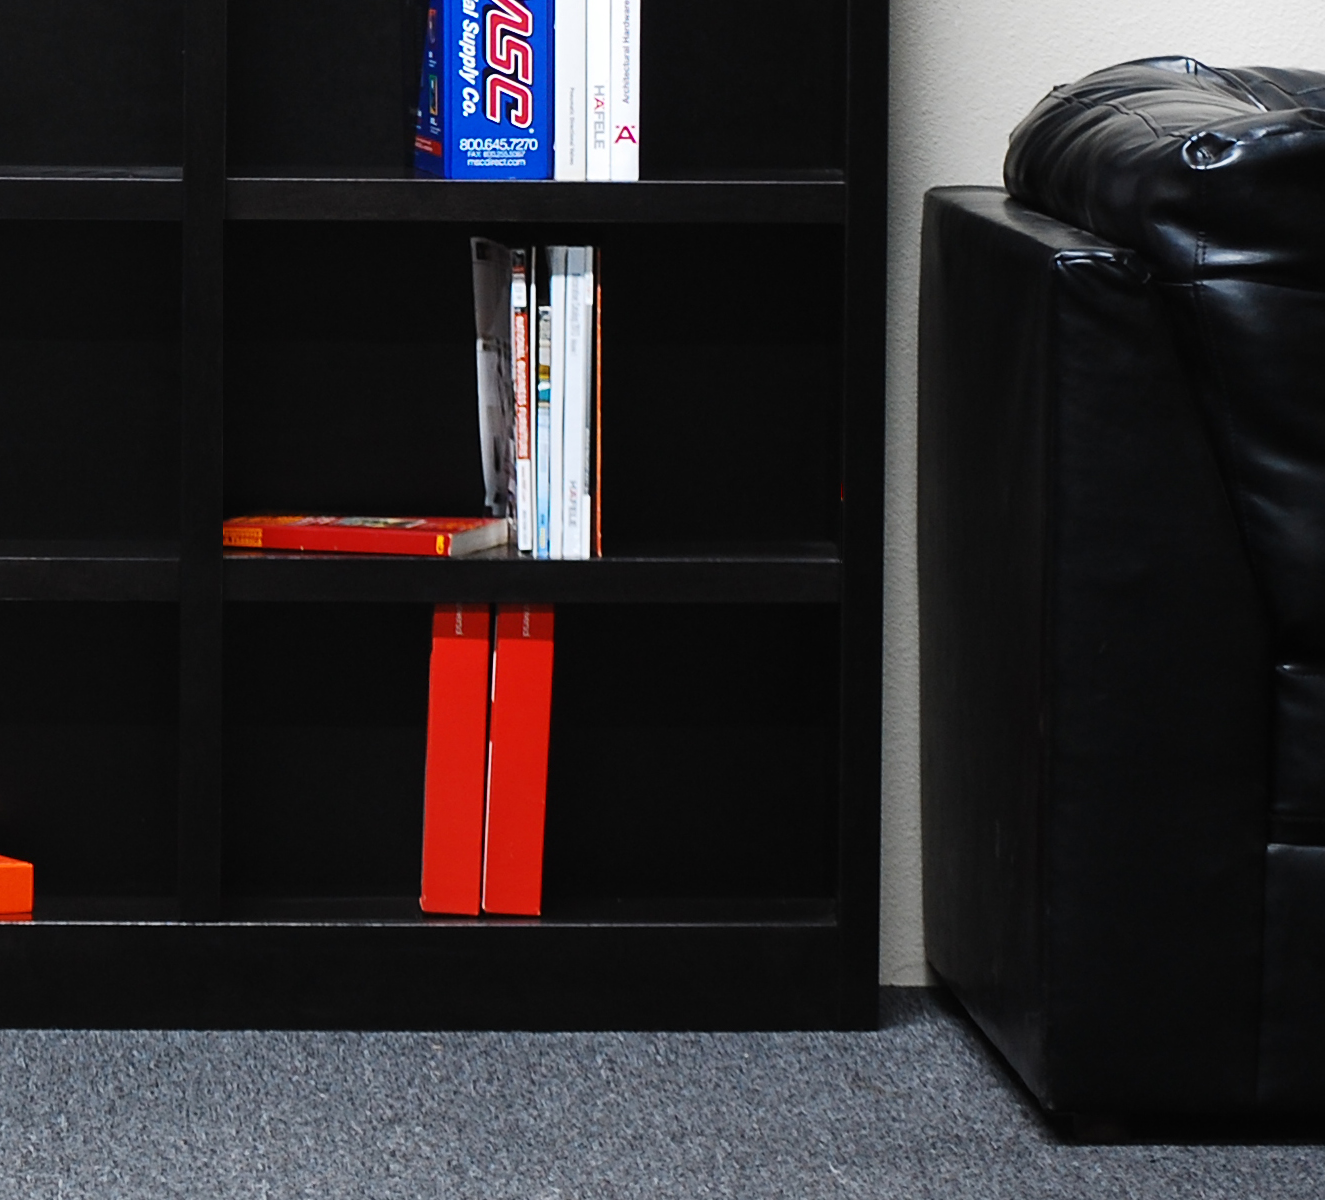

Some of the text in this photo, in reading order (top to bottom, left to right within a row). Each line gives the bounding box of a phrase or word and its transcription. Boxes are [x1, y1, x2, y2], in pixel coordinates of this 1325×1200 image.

[458, 19, 480, 85] Supply
[622, 46, 630, 104] Architectural
[462, 87, 480, 117] Co.
[459, 138, 538, 150] 800.645.7270
[467, 158, 526, 166] mscdirect.com
